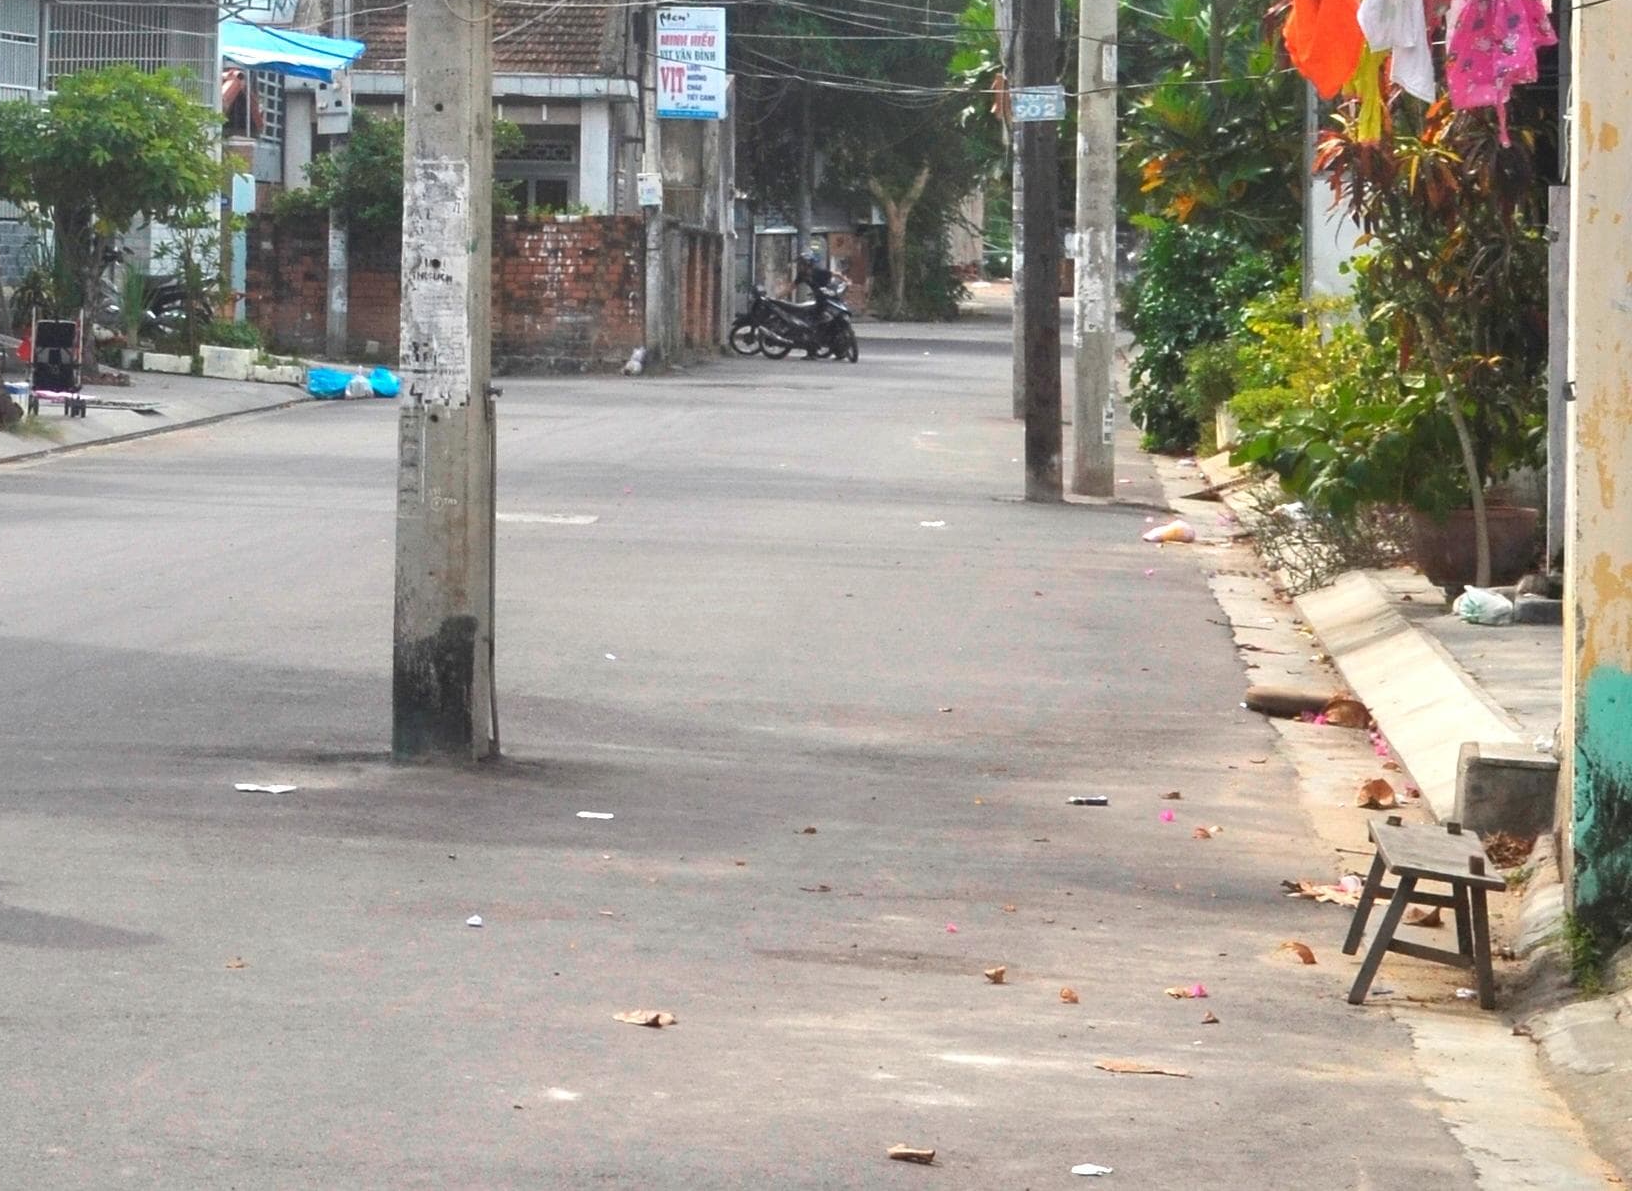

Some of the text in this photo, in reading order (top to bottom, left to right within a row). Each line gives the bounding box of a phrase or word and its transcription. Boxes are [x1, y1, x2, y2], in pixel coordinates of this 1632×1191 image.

[660, 34, 688, 46] MINH
[660, 66, 685, 101] VỊT
[1043, 103, 1057, 117] 2
